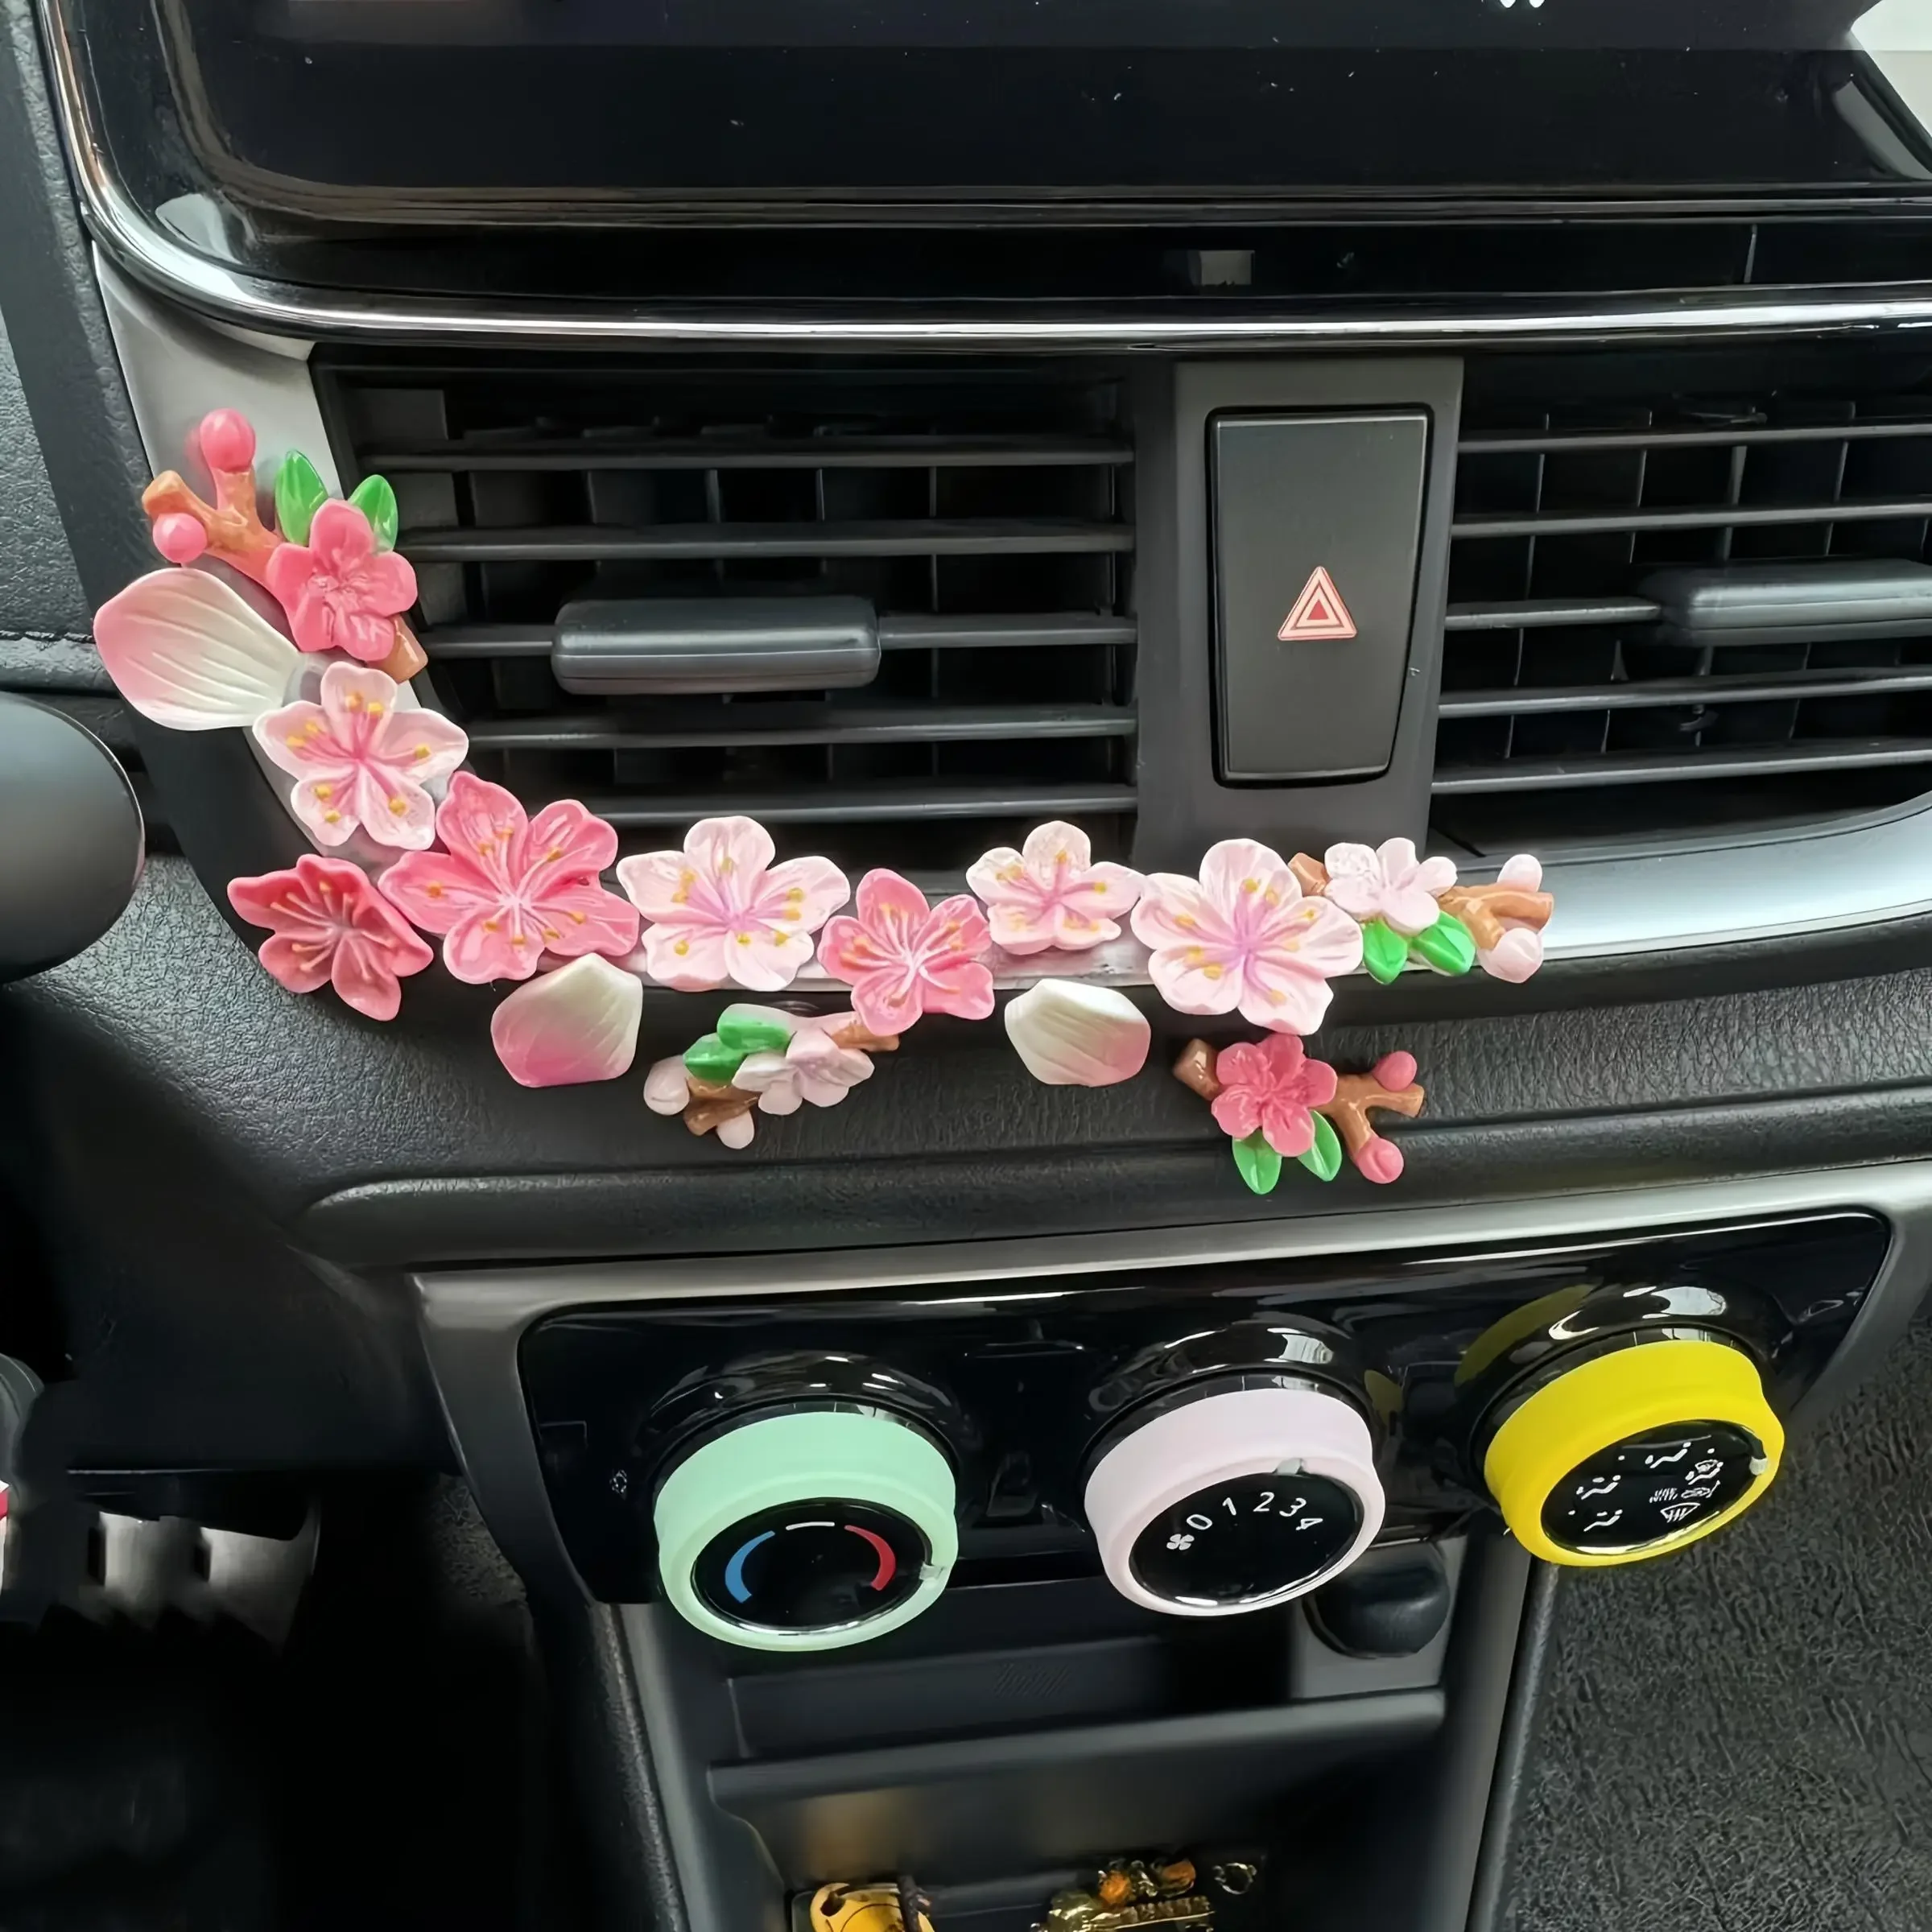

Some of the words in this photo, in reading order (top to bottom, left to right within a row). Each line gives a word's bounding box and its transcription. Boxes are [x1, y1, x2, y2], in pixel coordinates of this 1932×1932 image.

[1187, 1513, 1213, 1530] 0
[1222, 1497, 1236, 1516] 1
[1253, 1492, 1274, 1512] 2
[1279, 1497, 1307, 1517] 3
[1295, 1517, 1323, 1530] 4
